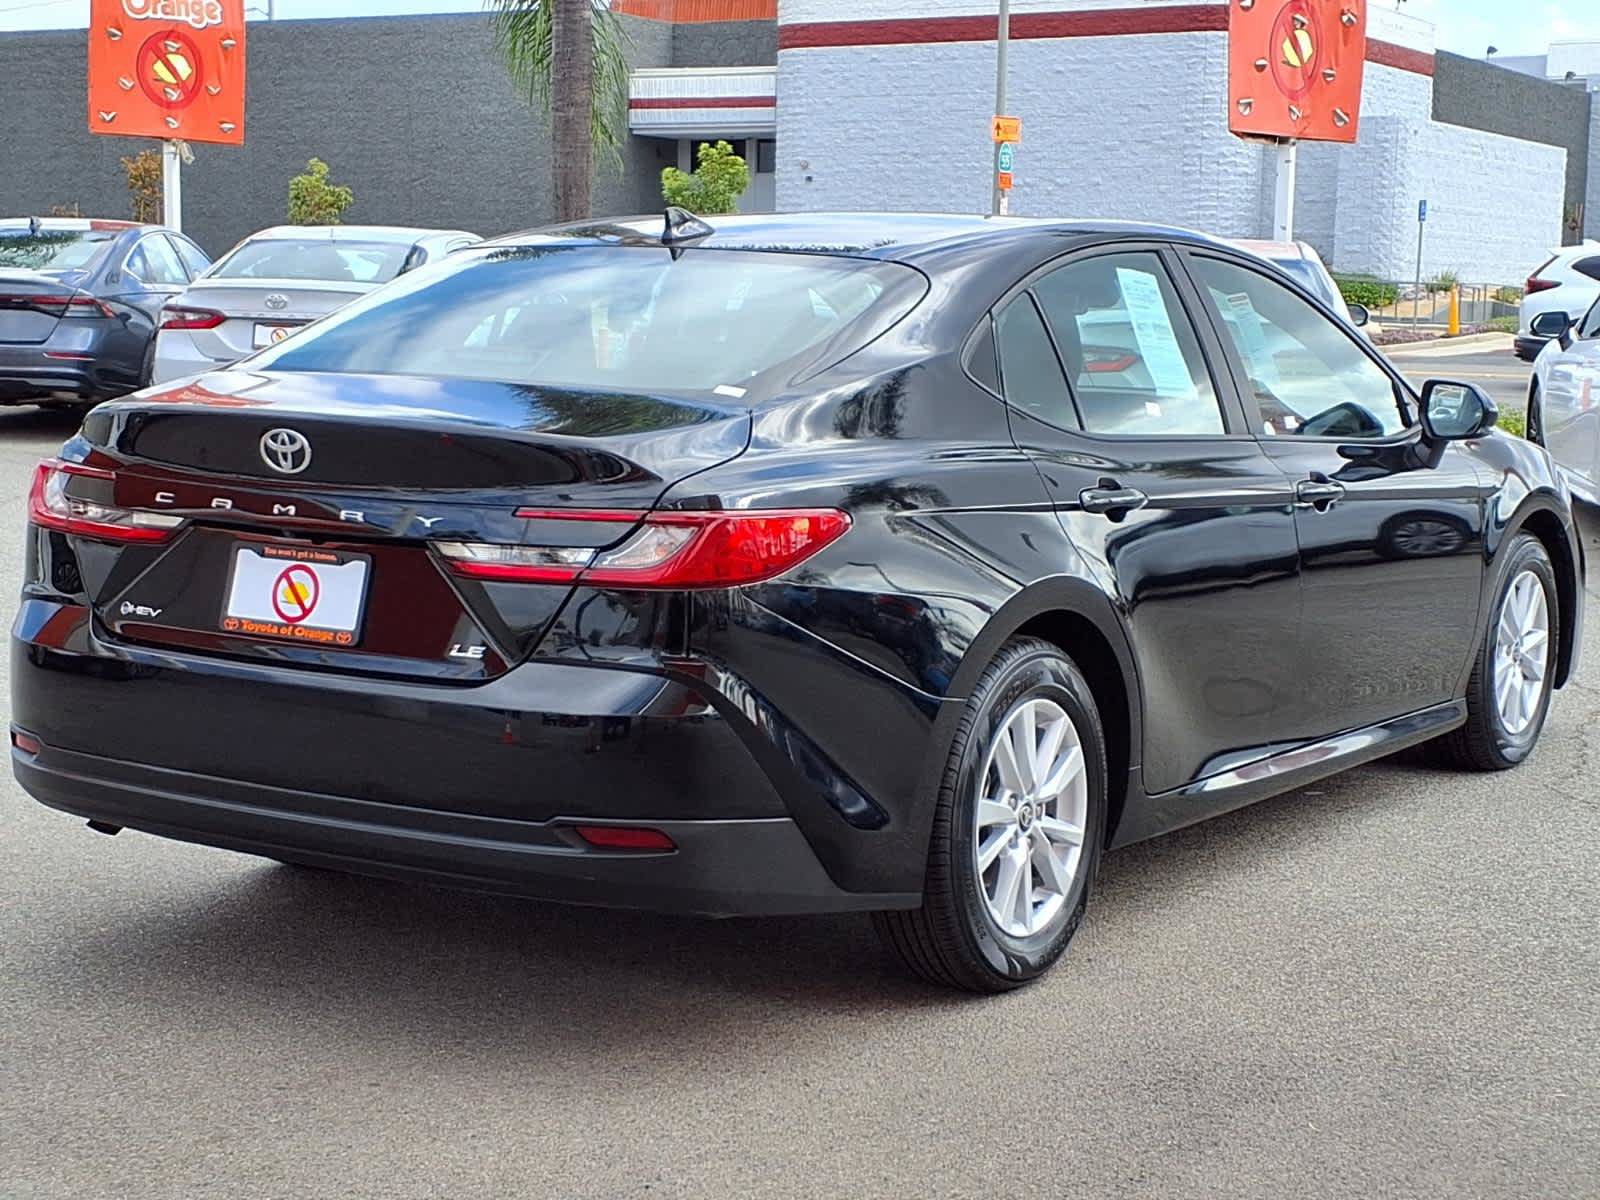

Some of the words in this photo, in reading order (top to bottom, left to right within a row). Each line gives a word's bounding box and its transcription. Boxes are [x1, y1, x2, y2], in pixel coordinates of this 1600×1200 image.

[122, 0, 223, 29] Orange
[155, 491, 444, 528] CAMRY
[130, 604, 162, 617] HEV
[241, 620, 279, 634] Toyota
[280, 626, 293, 636] of
[294, 627, 334, 642] Orange
[449, 644, 487, 659] LE
